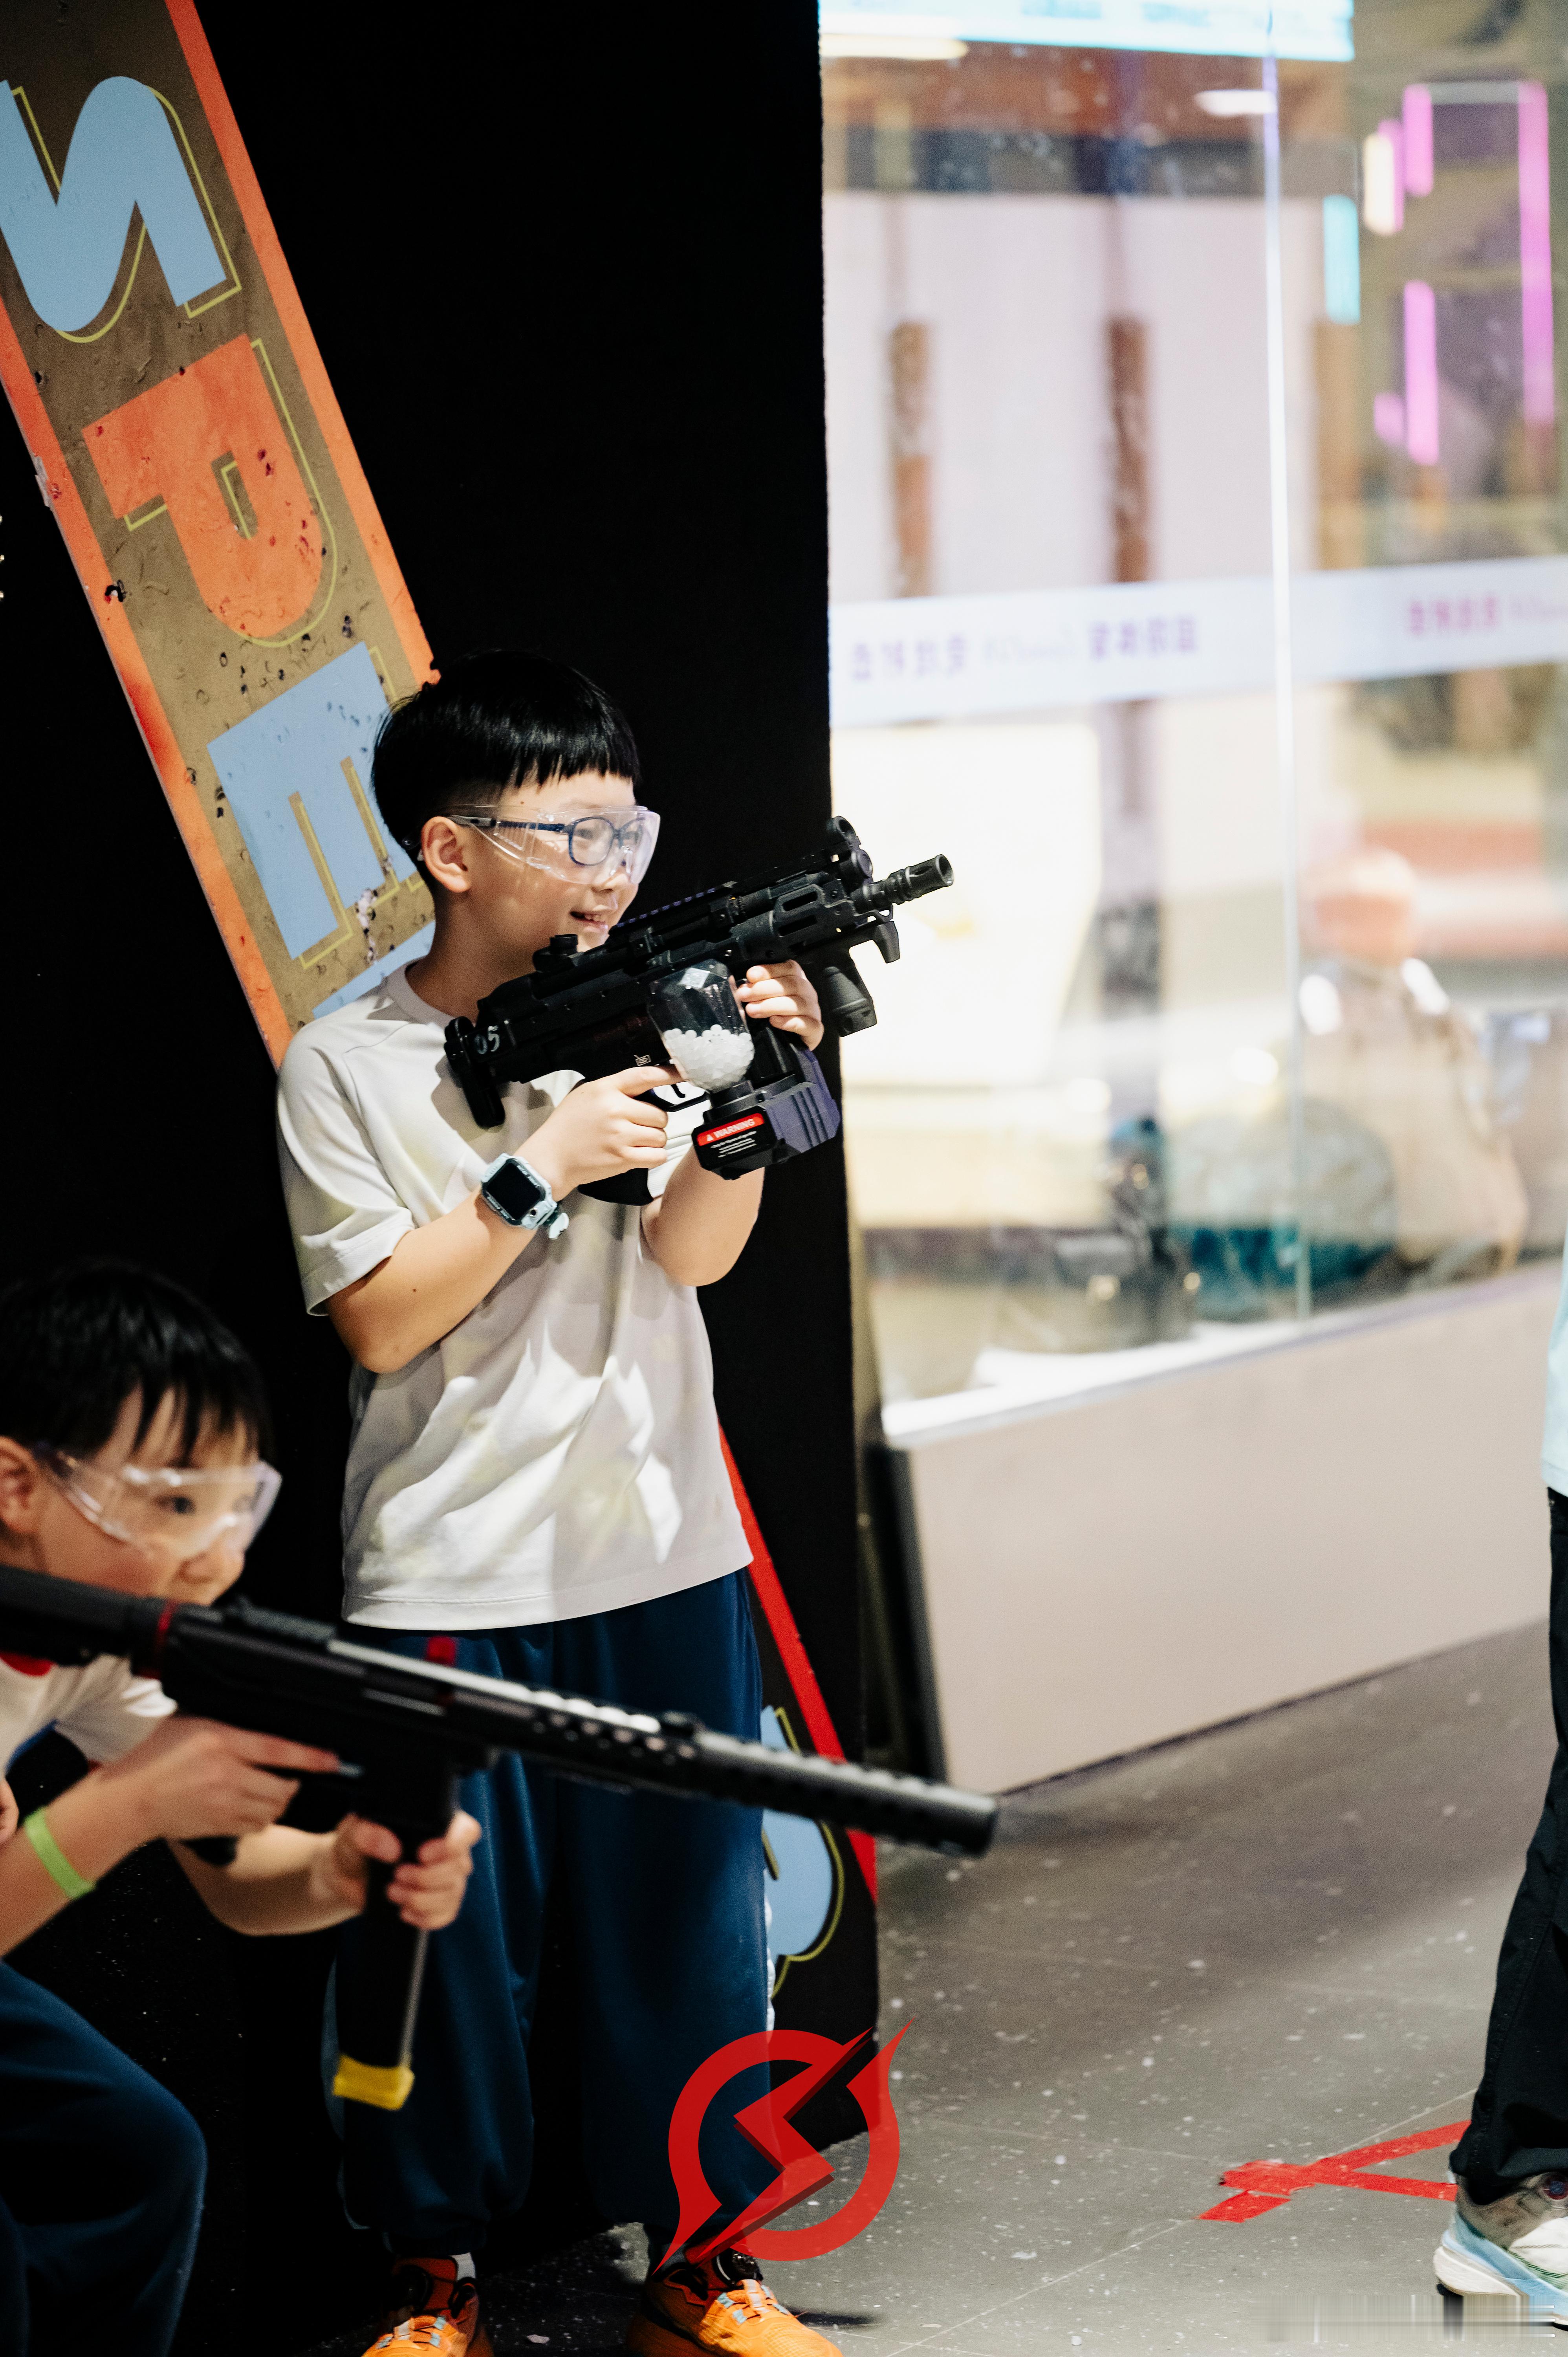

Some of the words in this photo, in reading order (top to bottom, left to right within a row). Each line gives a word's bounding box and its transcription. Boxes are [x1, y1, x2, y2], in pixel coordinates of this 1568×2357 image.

[0, 76, 435, 1017] SPE
[475, 1025, 500, 1054] 05
[713, 1118, 755, 1138] WARNING
